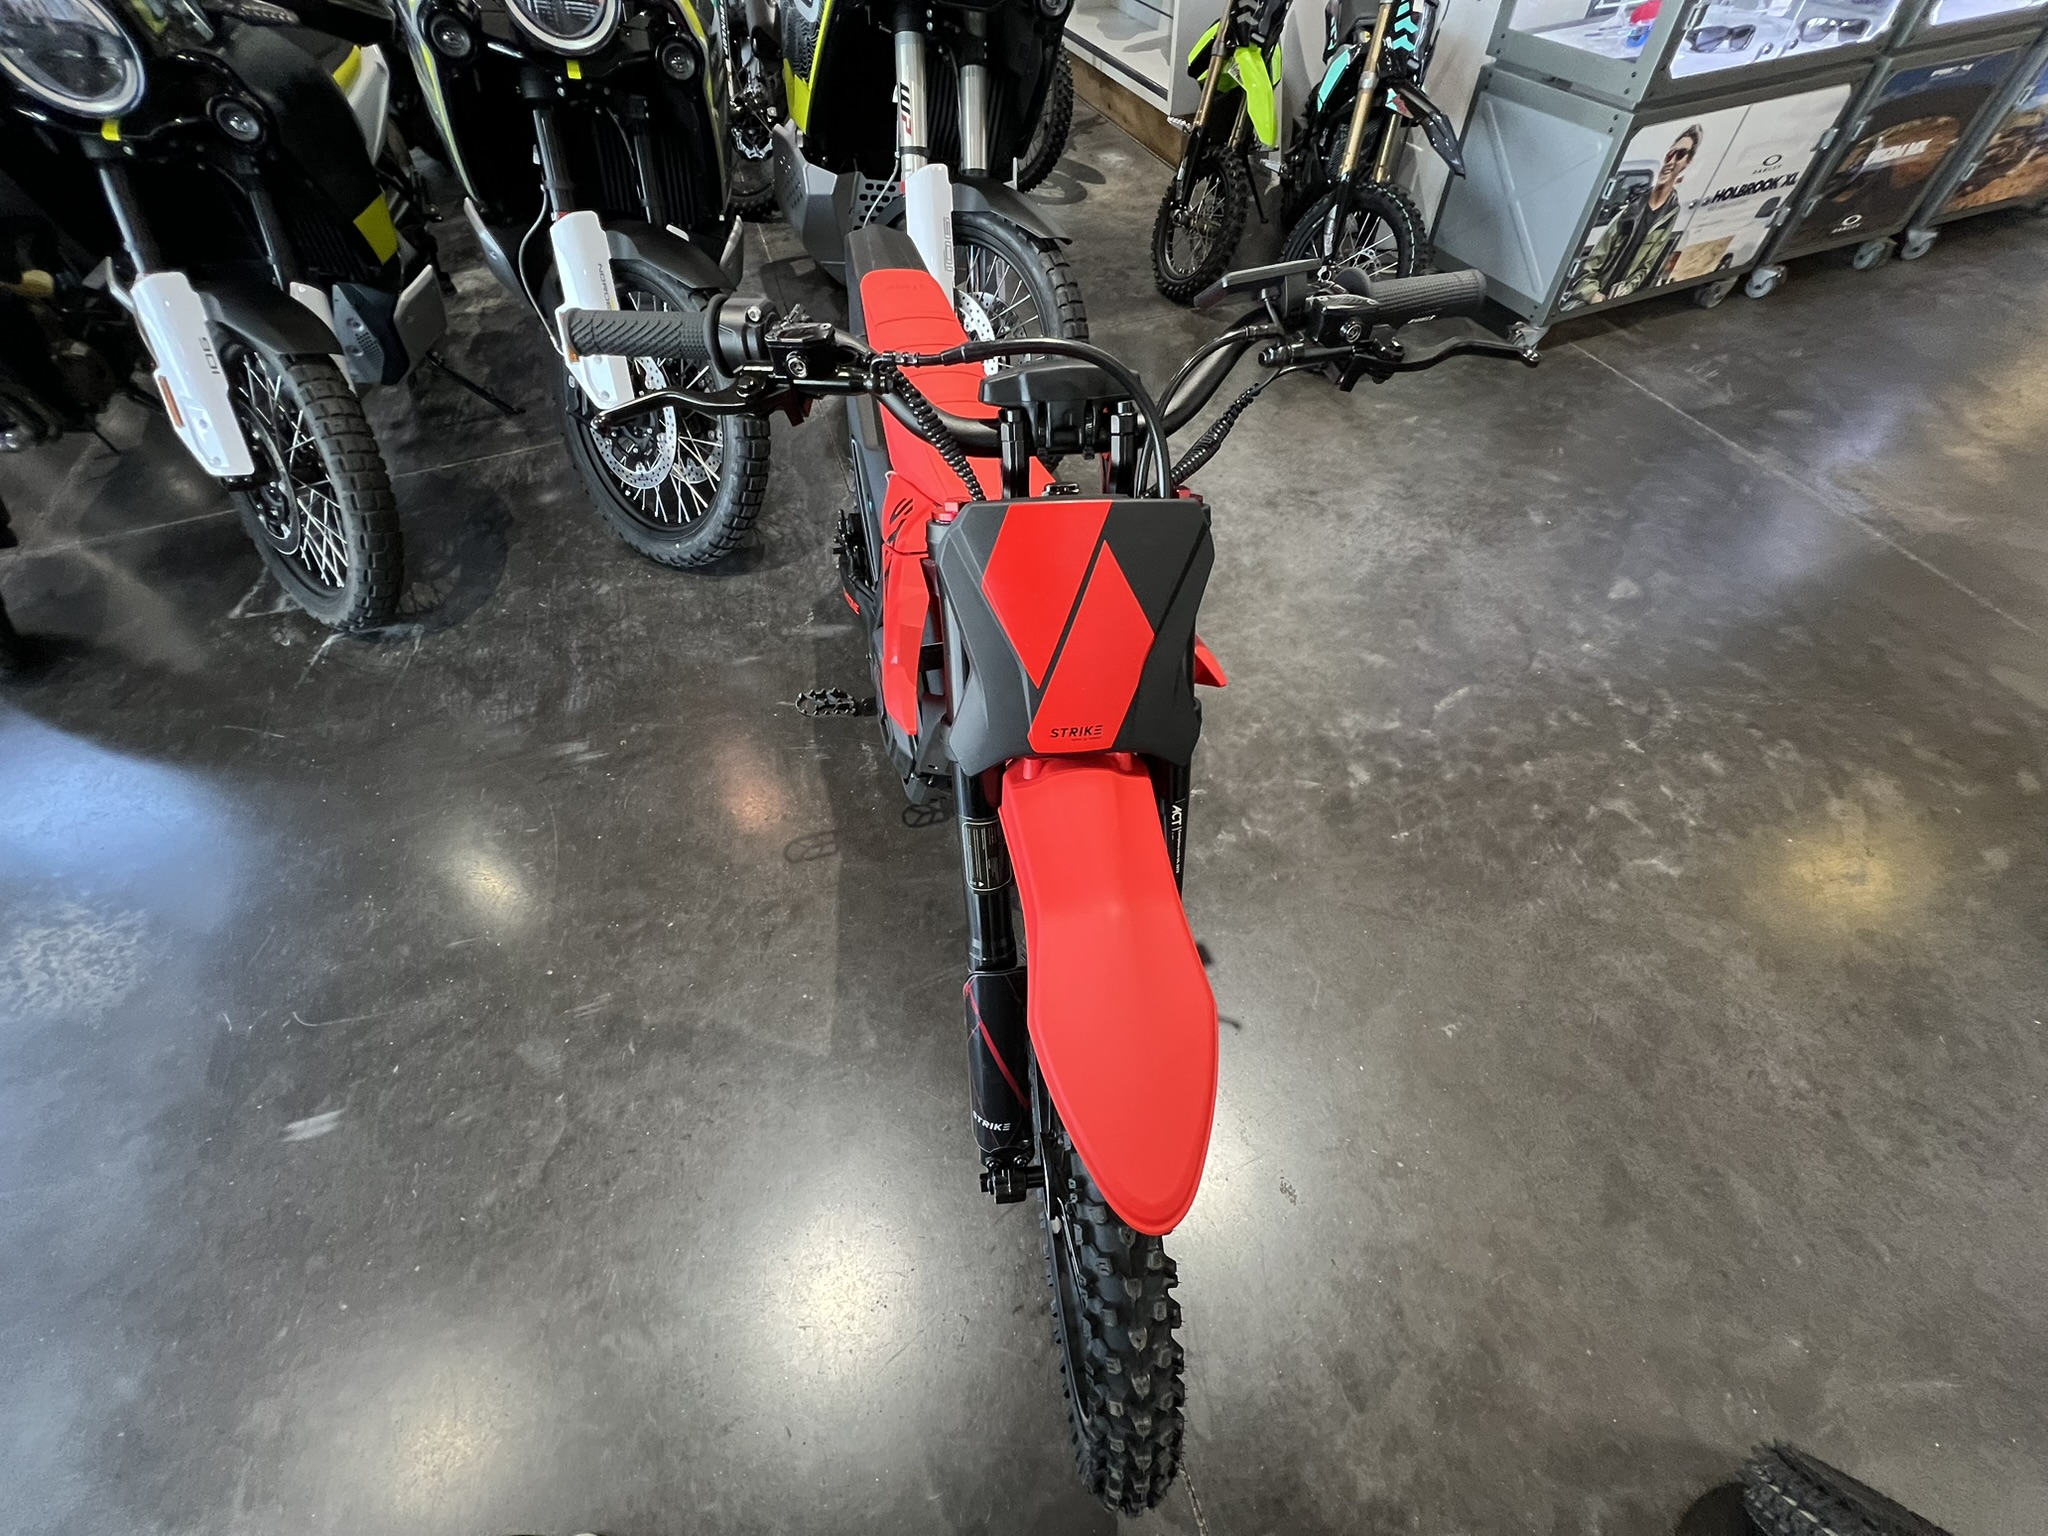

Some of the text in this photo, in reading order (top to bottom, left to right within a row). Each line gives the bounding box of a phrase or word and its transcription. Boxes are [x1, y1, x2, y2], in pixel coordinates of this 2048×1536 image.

[899, 81, 912, 136] WP
[1711, 171, 1800, 204] HOLBROOK XL
[597, 263, 612, 311] NORDE
[1050, 724, 1103, 738] STRIKE
[1171, 804, 1183, 826] ACT
[972, 1110, 1011, 1132] STRIKE
